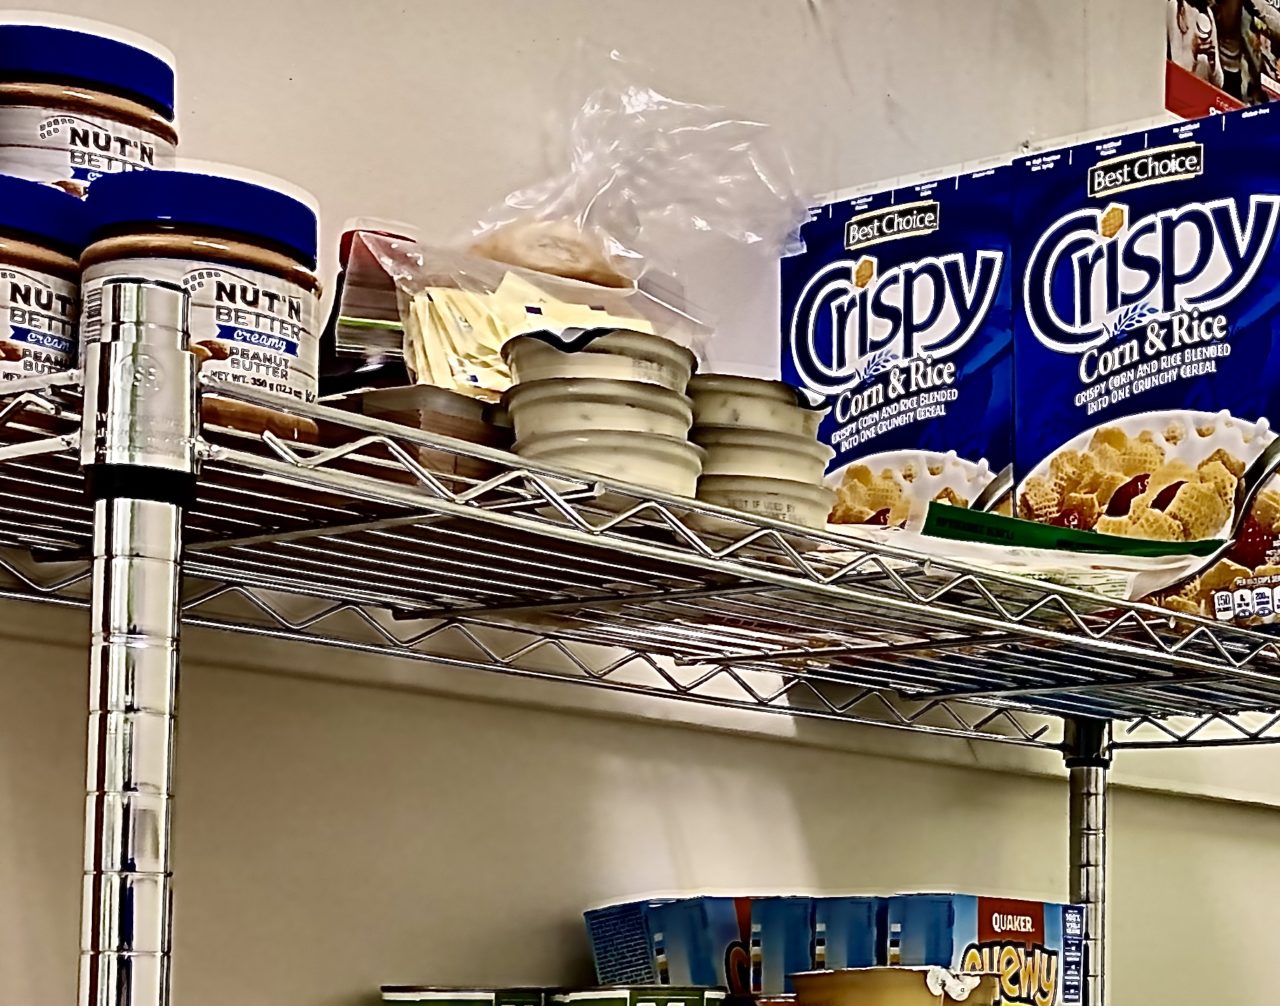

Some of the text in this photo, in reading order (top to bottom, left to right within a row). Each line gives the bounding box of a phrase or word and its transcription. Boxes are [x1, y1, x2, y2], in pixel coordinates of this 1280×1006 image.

[69, 126, 155, 166] NUT'N
[1094, 165, 1132, 192] Best
[849, 218, 881, 244] Best
[215, 280, 302, 323] NUT'N
[215, 304, 300, 341] BETTER
[233, 328, 287, 353] creamy
[791, 250, 1003, 395] Crispy
[229, 345, 290, 370] PEANUT
[1078, 307, 1228, 384] Corn & Rice
[230, 357, 289, 381] BUTTER
[1074, 343, 1232, 407] CRISPY CORN AND RICE BLENDED
[1086, 359, 1218, 416] INTO ONE CRUNCHY CEREAL
[834, 356, 957, 424] Corn & Rice
[831, 388, 959, 445] CRISPY CORN AND RICE BLENDED
[839, 435, 859, 453] INTO
[860, 429, 877, 444] ONE
[877, 413, 916, 436] CRUNCHY
[1216, 593, 1231, 608] 150
[991, 912, 1032, 933] QUAKER
